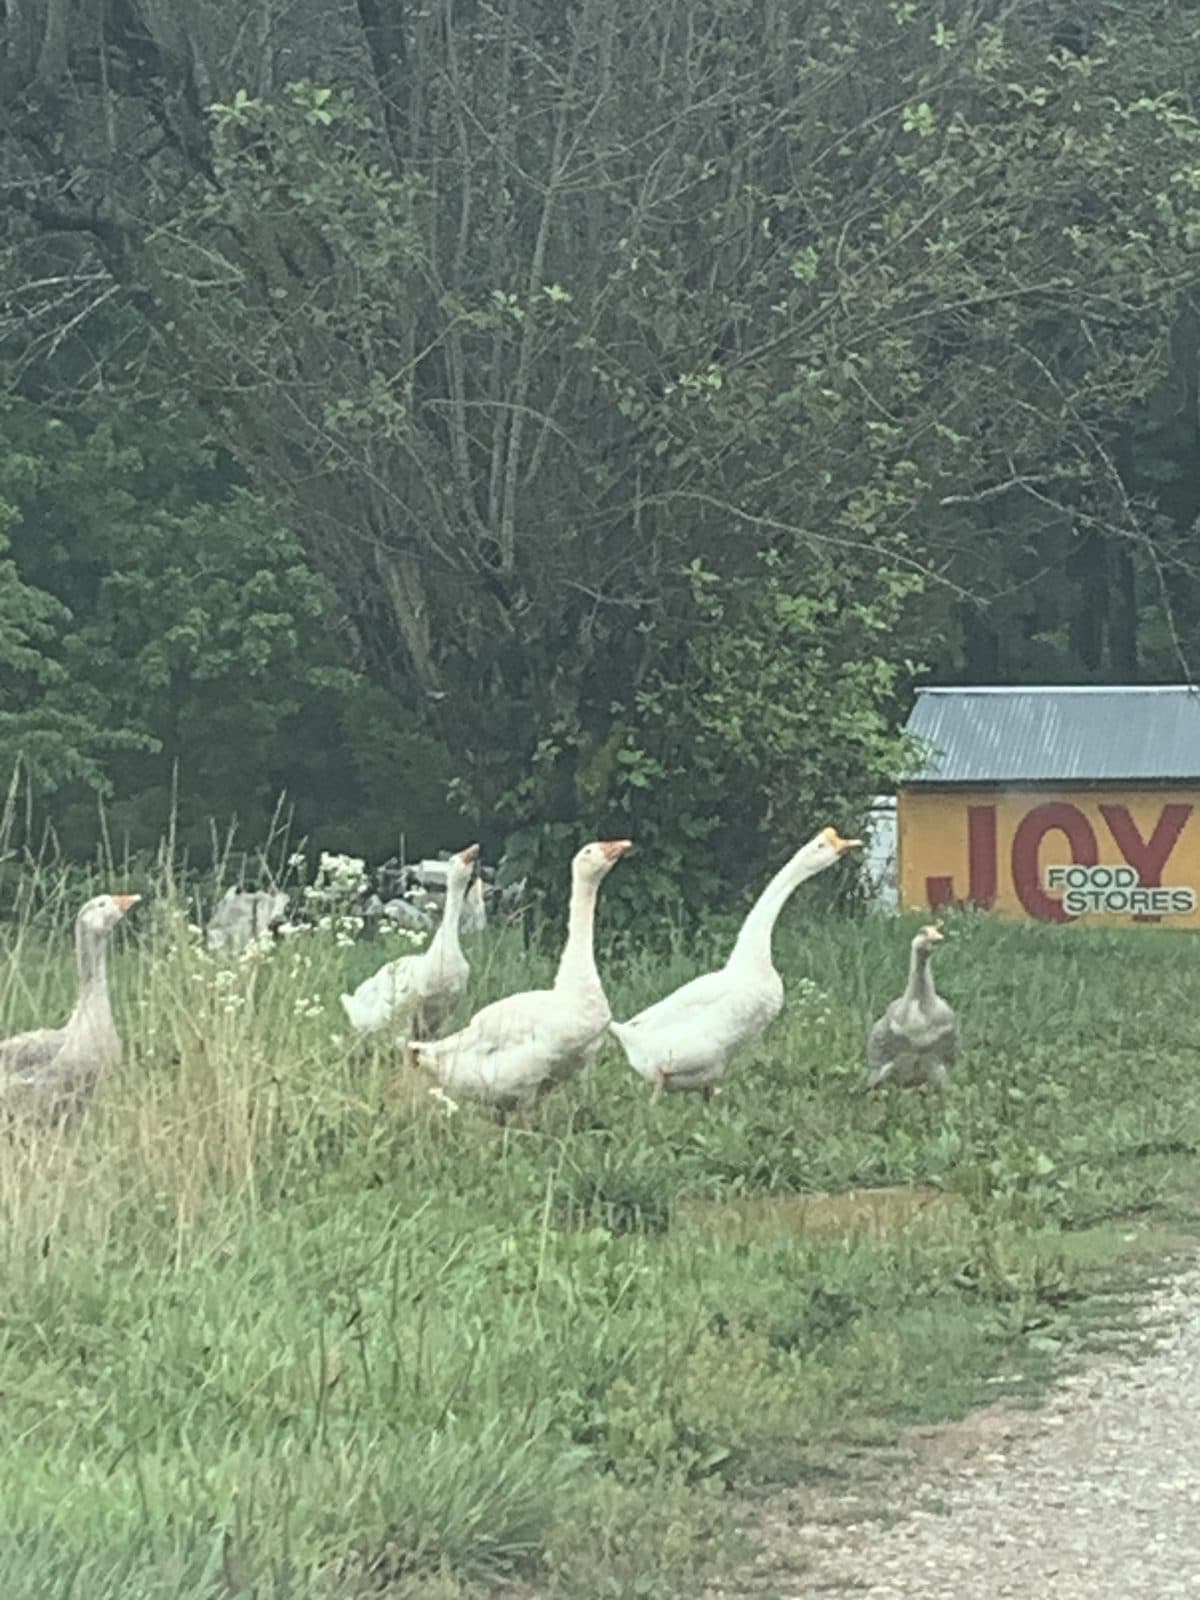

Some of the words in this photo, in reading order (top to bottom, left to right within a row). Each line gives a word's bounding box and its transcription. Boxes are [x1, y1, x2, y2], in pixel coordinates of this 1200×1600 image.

[925, 801, 1194, 923] JOY
[1048, 867, 1136, 889] FOOD
[1066, 890, 1194, 913] STORES
